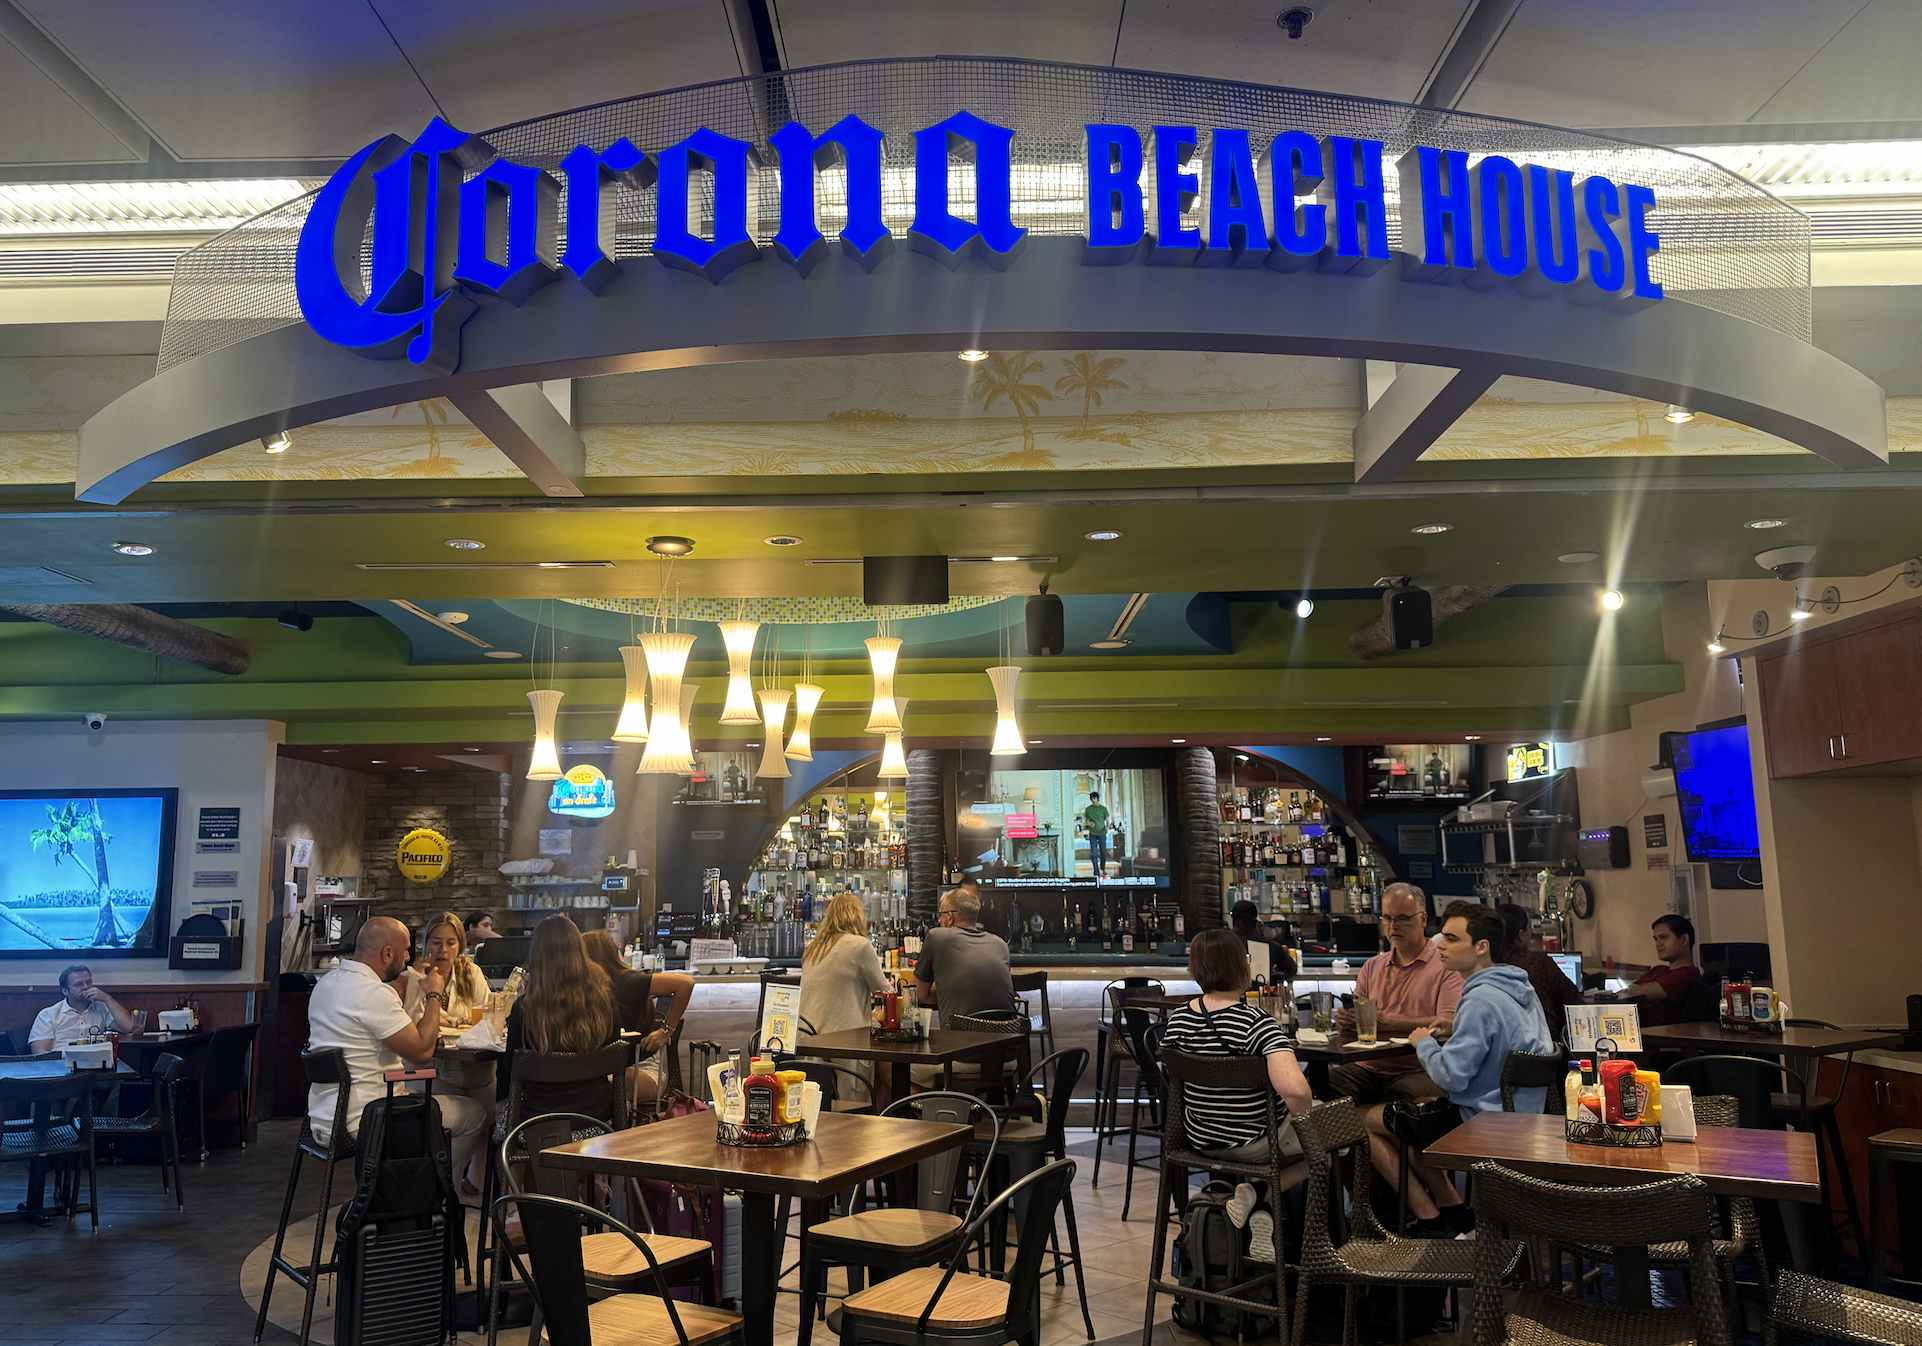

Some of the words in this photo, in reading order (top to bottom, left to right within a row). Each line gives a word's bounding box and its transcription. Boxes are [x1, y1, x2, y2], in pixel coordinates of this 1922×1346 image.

[295, 109, 1028, 365] Corona
[1084, 123, 1392, 261] BEACH
[1416, 144, 1664, 301] HOUSE
[402, 852, 443, 863] PACIFICO
